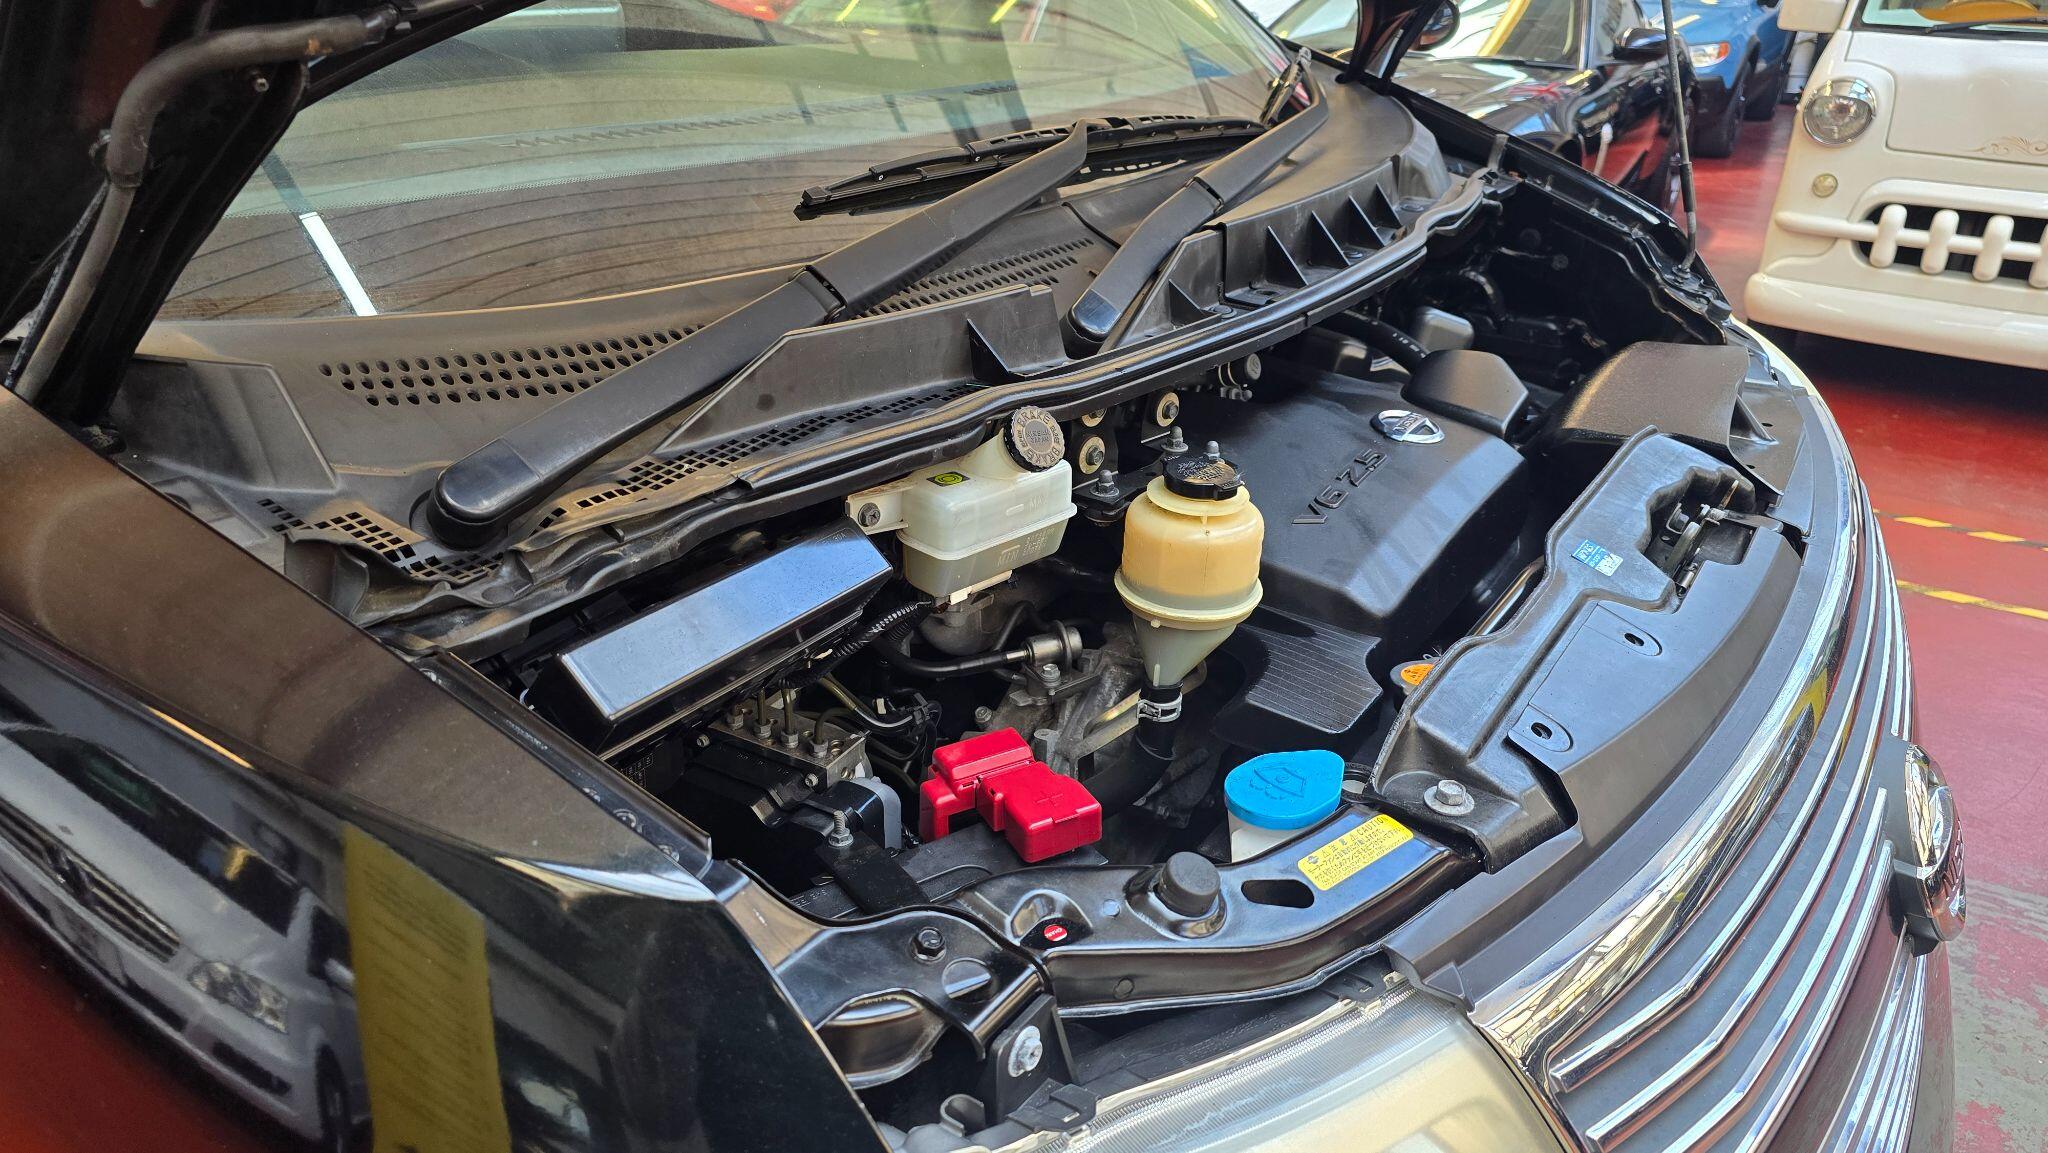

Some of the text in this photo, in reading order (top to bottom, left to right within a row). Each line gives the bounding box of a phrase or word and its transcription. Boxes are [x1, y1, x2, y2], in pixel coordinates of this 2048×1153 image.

[1017, 409, 1051, 428] BRAKE
[1026, 446, 1060, 465] BRAKE
[1291, 484, 1349, 525] V6
[1356, 816, 1389, 836] CAUTION
